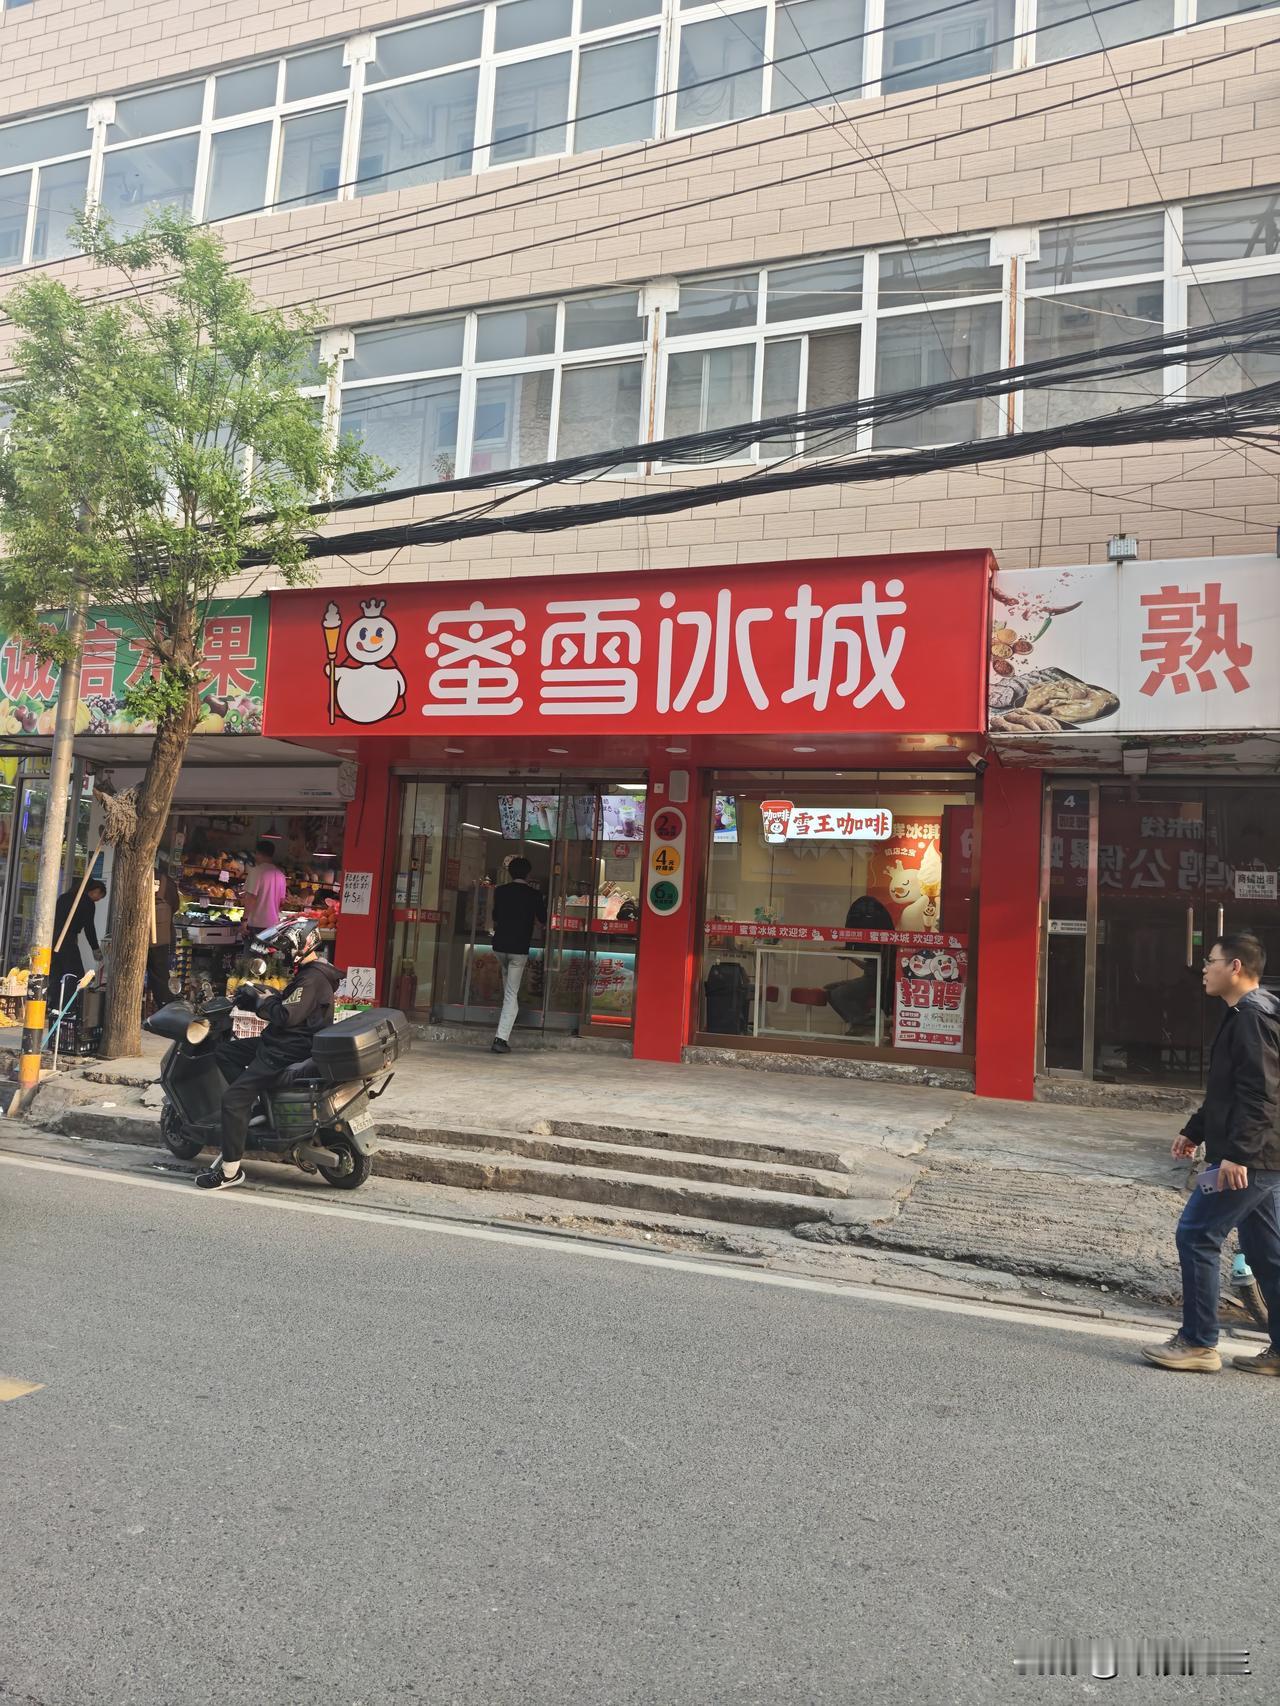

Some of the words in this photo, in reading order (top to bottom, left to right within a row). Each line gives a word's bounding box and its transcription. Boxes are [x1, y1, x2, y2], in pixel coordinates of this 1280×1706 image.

[421, 577, 907, 717] 蜜雪冰城
[1139, 582, 1253, 697] 熟
[1063, 794, 1076, 808] 4
[792, 811, 890, 837] 雪王咖啡
[739, 924, 776, 937] 蜜雪冰城
[779, 926, 808, 938] 欢迎您
[869, 931, 910, 943] 蜜雪冰城
[913, 933, 944, 945] 欢迎您
[899, 978, 964, 1010] 招聘
